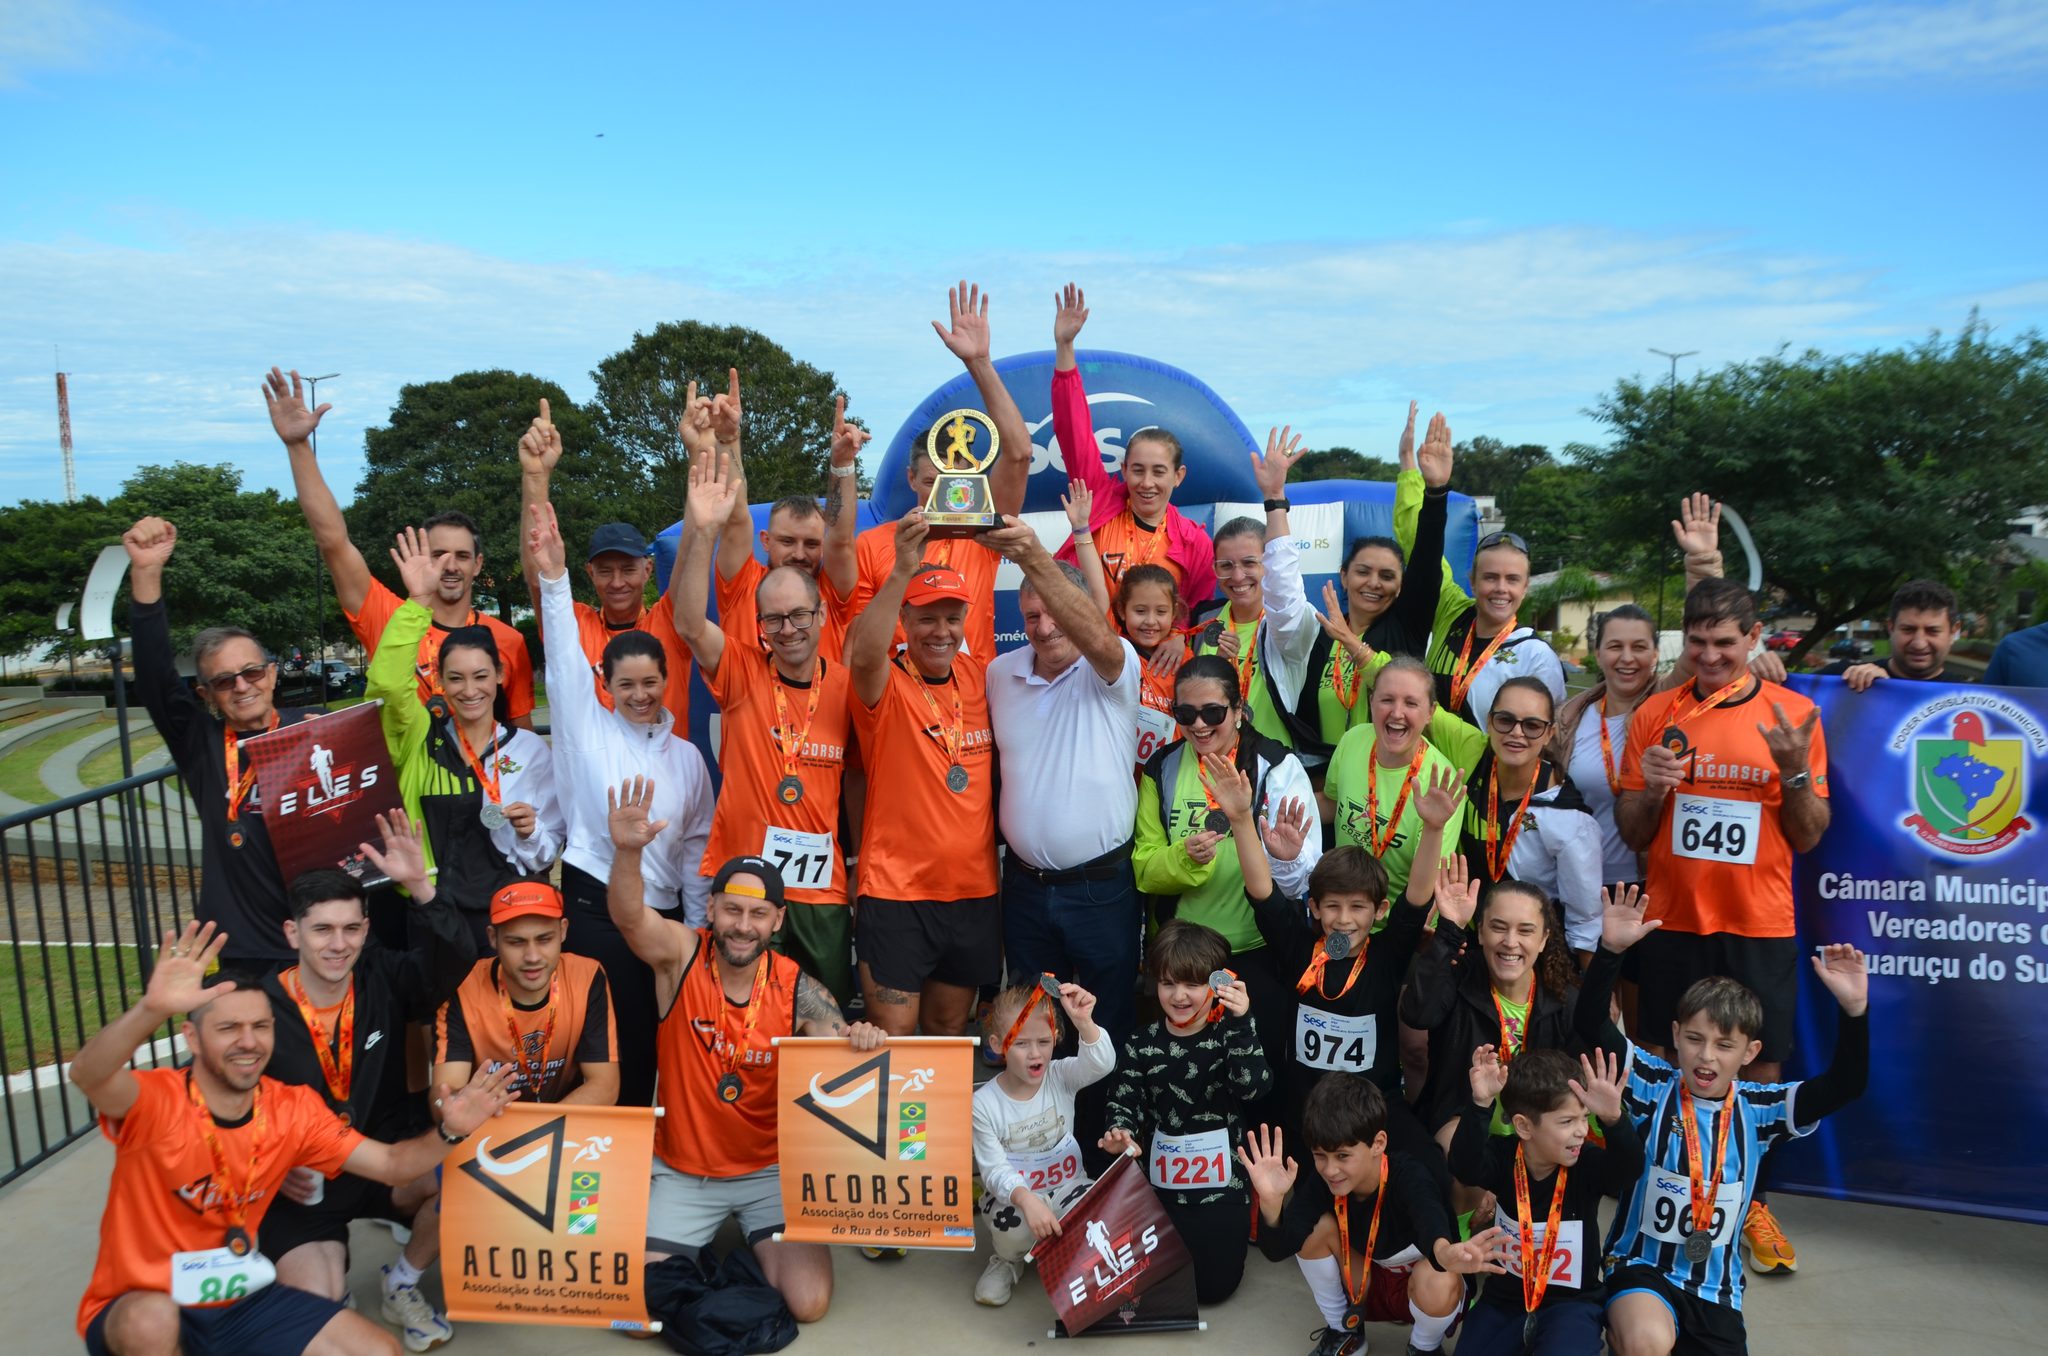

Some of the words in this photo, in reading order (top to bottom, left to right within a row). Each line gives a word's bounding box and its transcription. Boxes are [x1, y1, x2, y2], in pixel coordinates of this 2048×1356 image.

[1314, 538, 1330, 549] RS
[1921, 696, 1997, 718] LEGISLATIVO
[279, 764, 379, 816] ELES
[1682, 818, 1746, 857] 649
[773, 849, 829, 884] 717
[1818, 872, 1926, 901] Câmara
[1867, 910, 2032, 944] Vereadores
[1968, 953, 2006, 980] do
[1304, 1029, 1365, 1067] 974
[1018, 1155, 1077, 1191] 259
[1155, 1152, 1225, 1184] 1221
[802, 1173, 958, 1207] ACORSEB
[801, 1206, 864, 1221] Associação
[868, 1208, 889, 1220] dos
[892, 1209, 959, 1222] Corredores
[831, 1224, 846, 1235] de
[849, 1226, 871, 1236] Rua
[875, 1226, 890, 1236] de
[893, 1227, 931, 1238] Seberi
[463, 1245, 628, 1286] ACORSEB
[1068, 1224, 1159, 1306] ELES
[199, 1273, 250, 1303] 86
[463, 1281, 530, 1297] Associação
[533, 1284, 556, 1298] dos
[559, 1286, 630, 1302] Corredores
